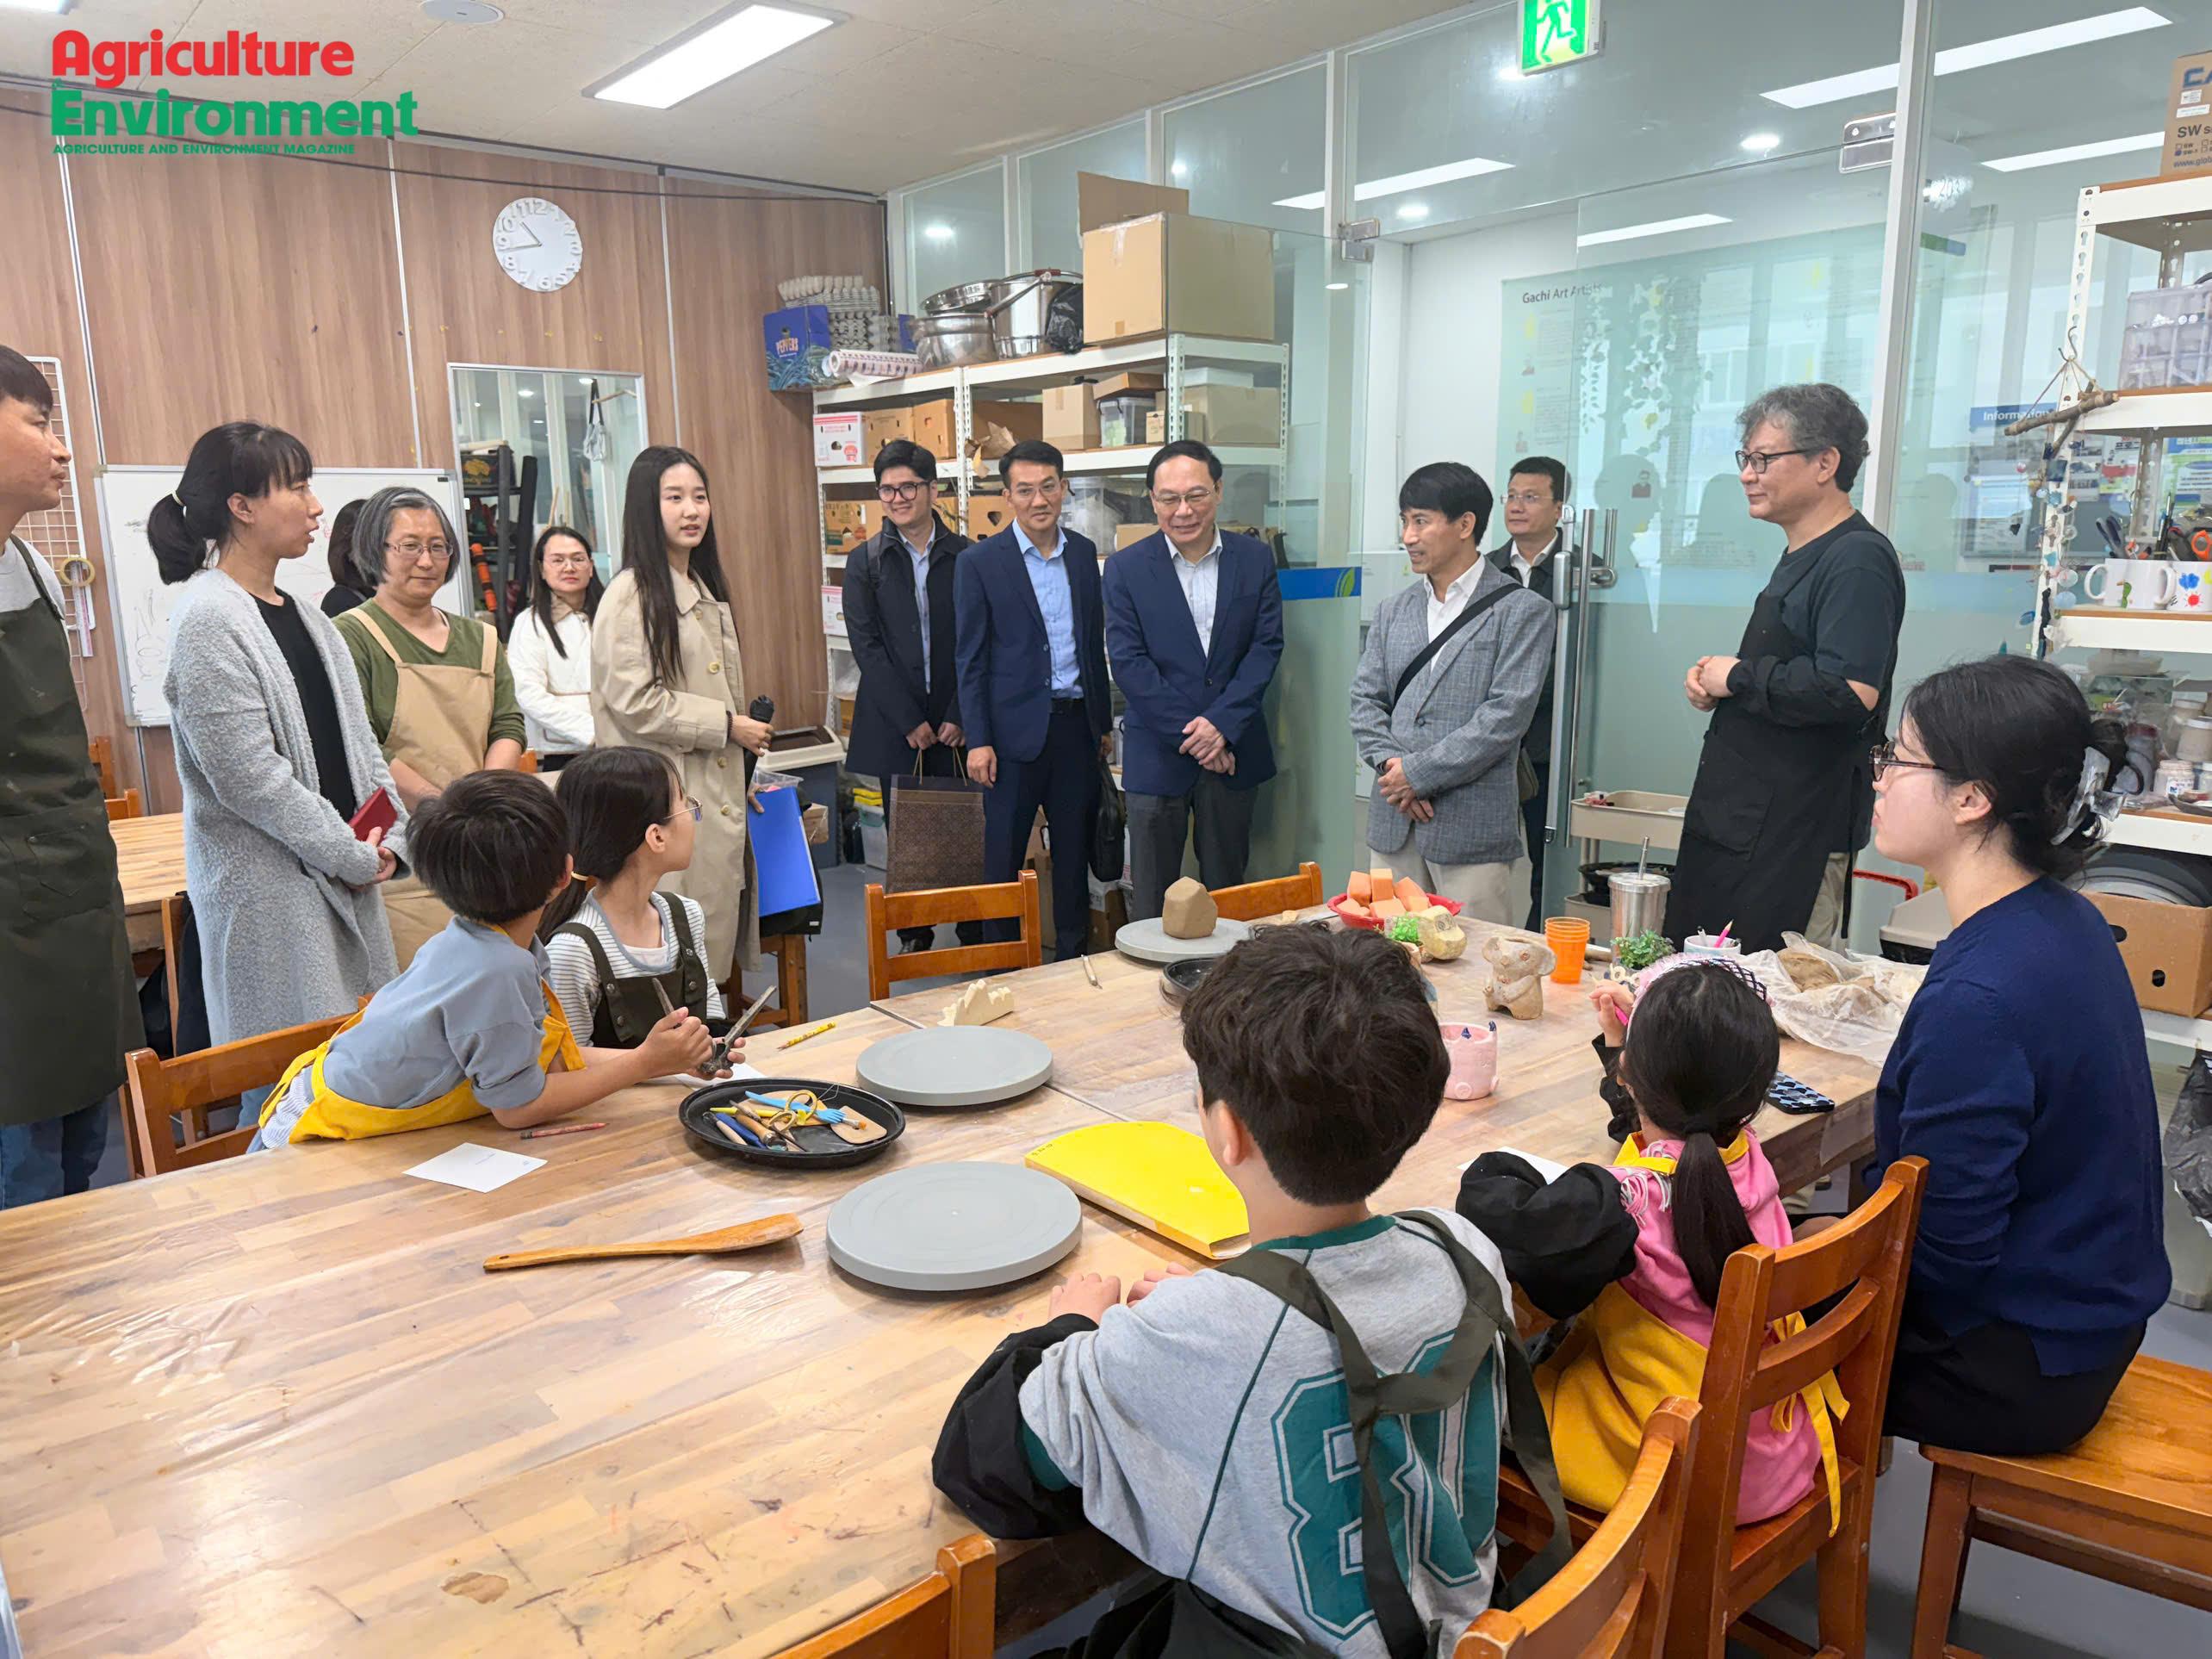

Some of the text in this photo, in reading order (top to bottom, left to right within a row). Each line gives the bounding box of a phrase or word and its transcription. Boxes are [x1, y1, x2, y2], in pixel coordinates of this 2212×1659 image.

[2178, 124, 2202, 138] SW
[1522, 289, 1550, 303] Gachi
[1553, 287, 1569, 298] Art
